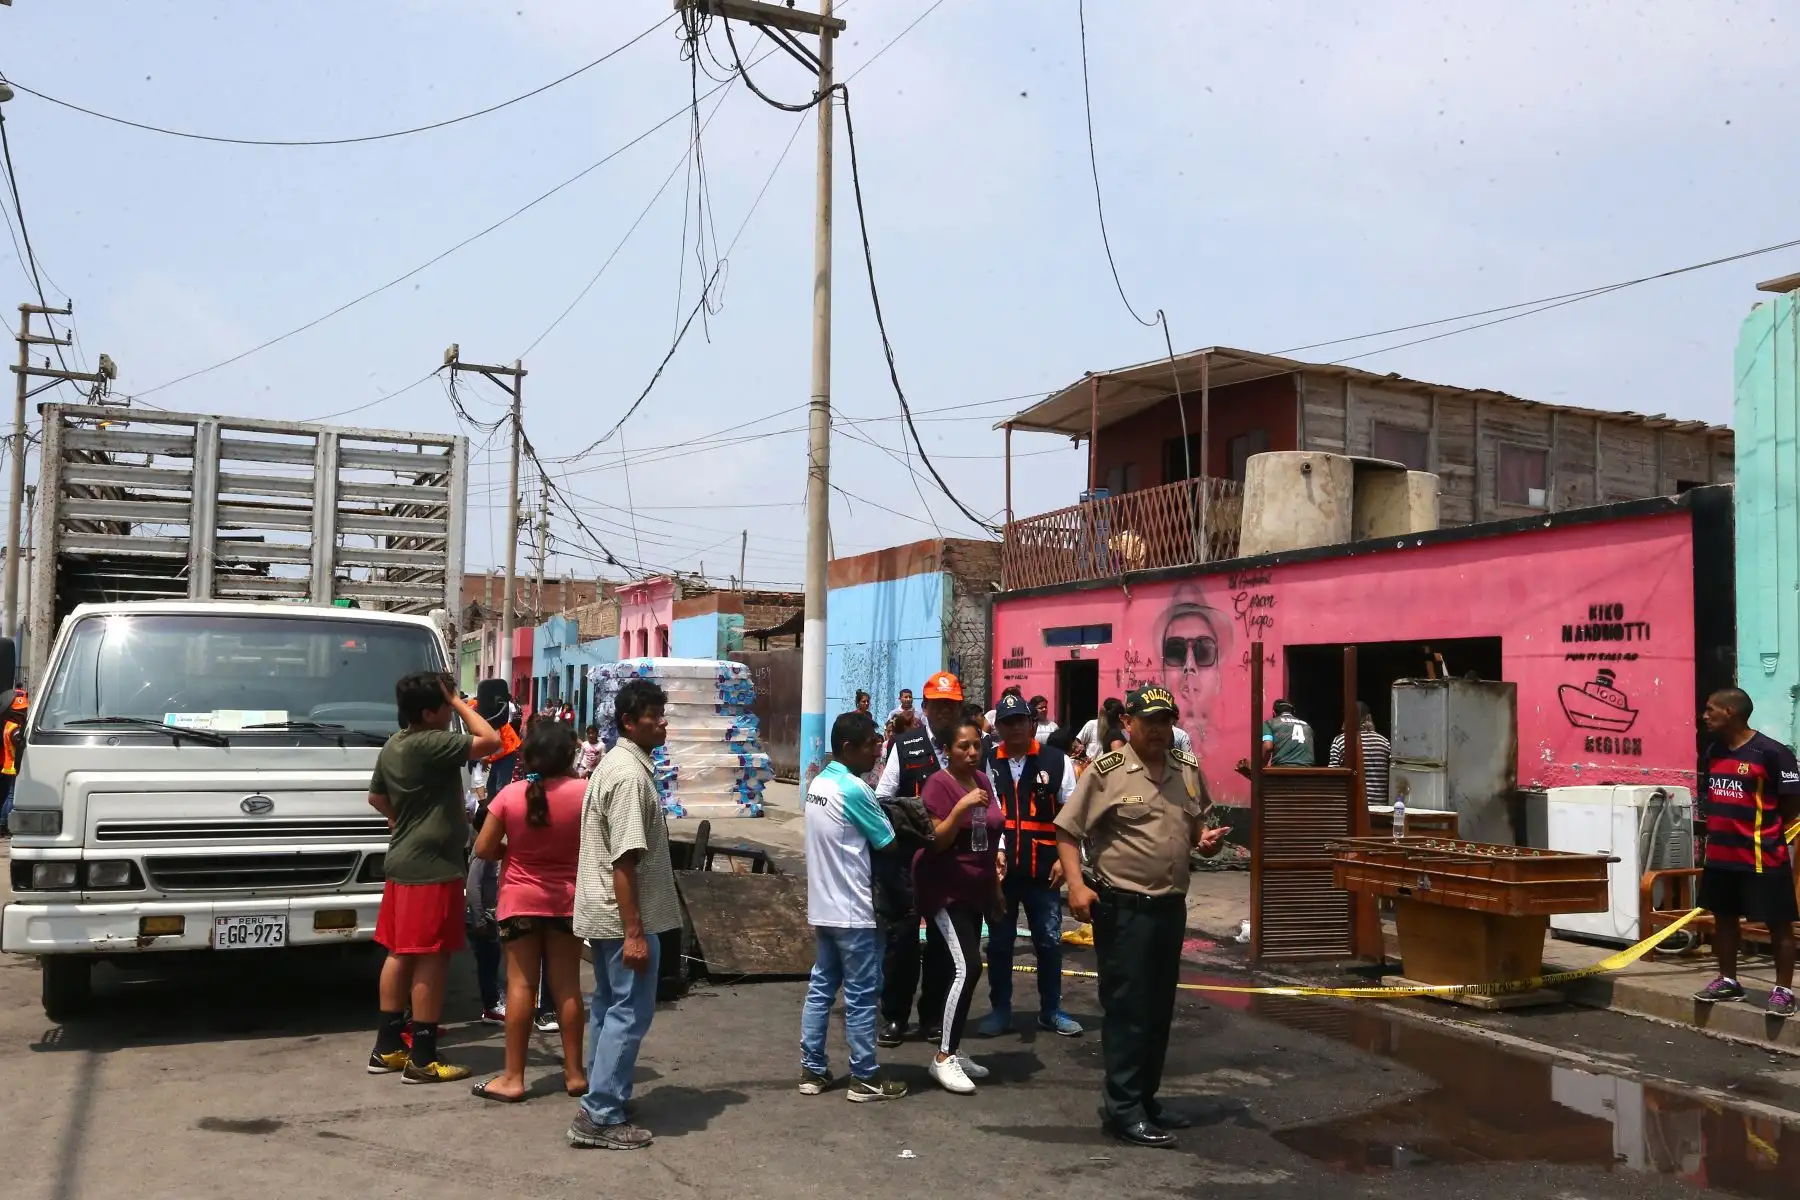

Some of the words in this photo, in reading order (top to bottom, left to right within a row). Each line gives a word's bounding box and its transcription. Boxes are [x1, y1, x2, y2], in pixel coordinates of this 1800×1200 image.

[1589, 603, 1624, 621] KIKO
[1291, 723, 1305, 744] 4
[1709, 777, 1743, 791] QATAR
[1714, 789, 1743, 798] AIRWAYS
